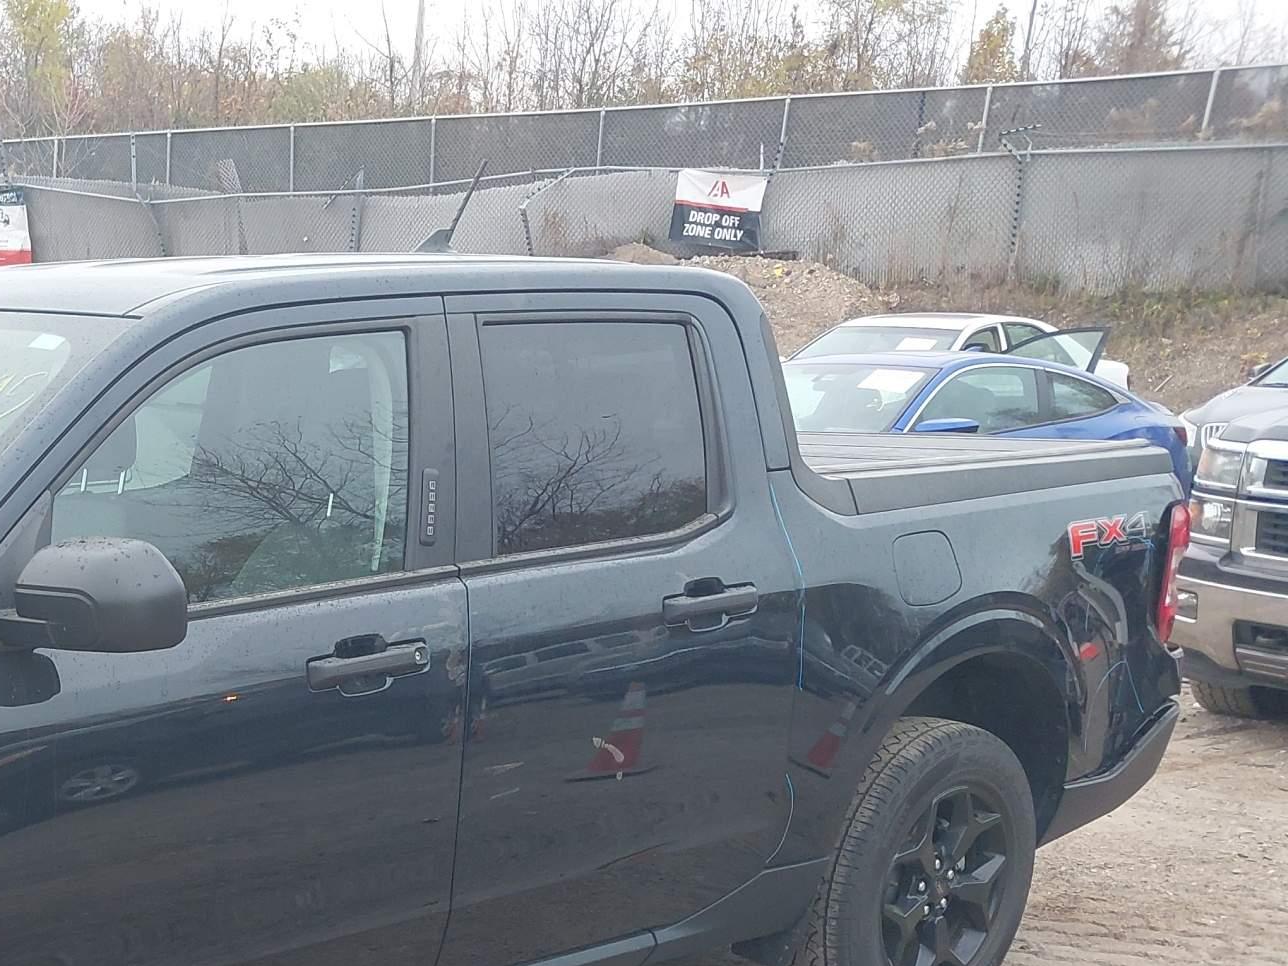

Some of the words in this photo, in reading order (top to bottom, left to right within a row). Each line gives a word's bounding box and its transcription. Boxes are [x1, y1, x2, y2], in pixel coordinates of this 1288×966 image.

[688, 210, 721, 226] DROP
[721, 214, 741, 227] OFF
[682, 223, 712, 239] ZONE
[713, 227, 744, 241] ONLY
[1067, 510, 1153, 561] FX4
